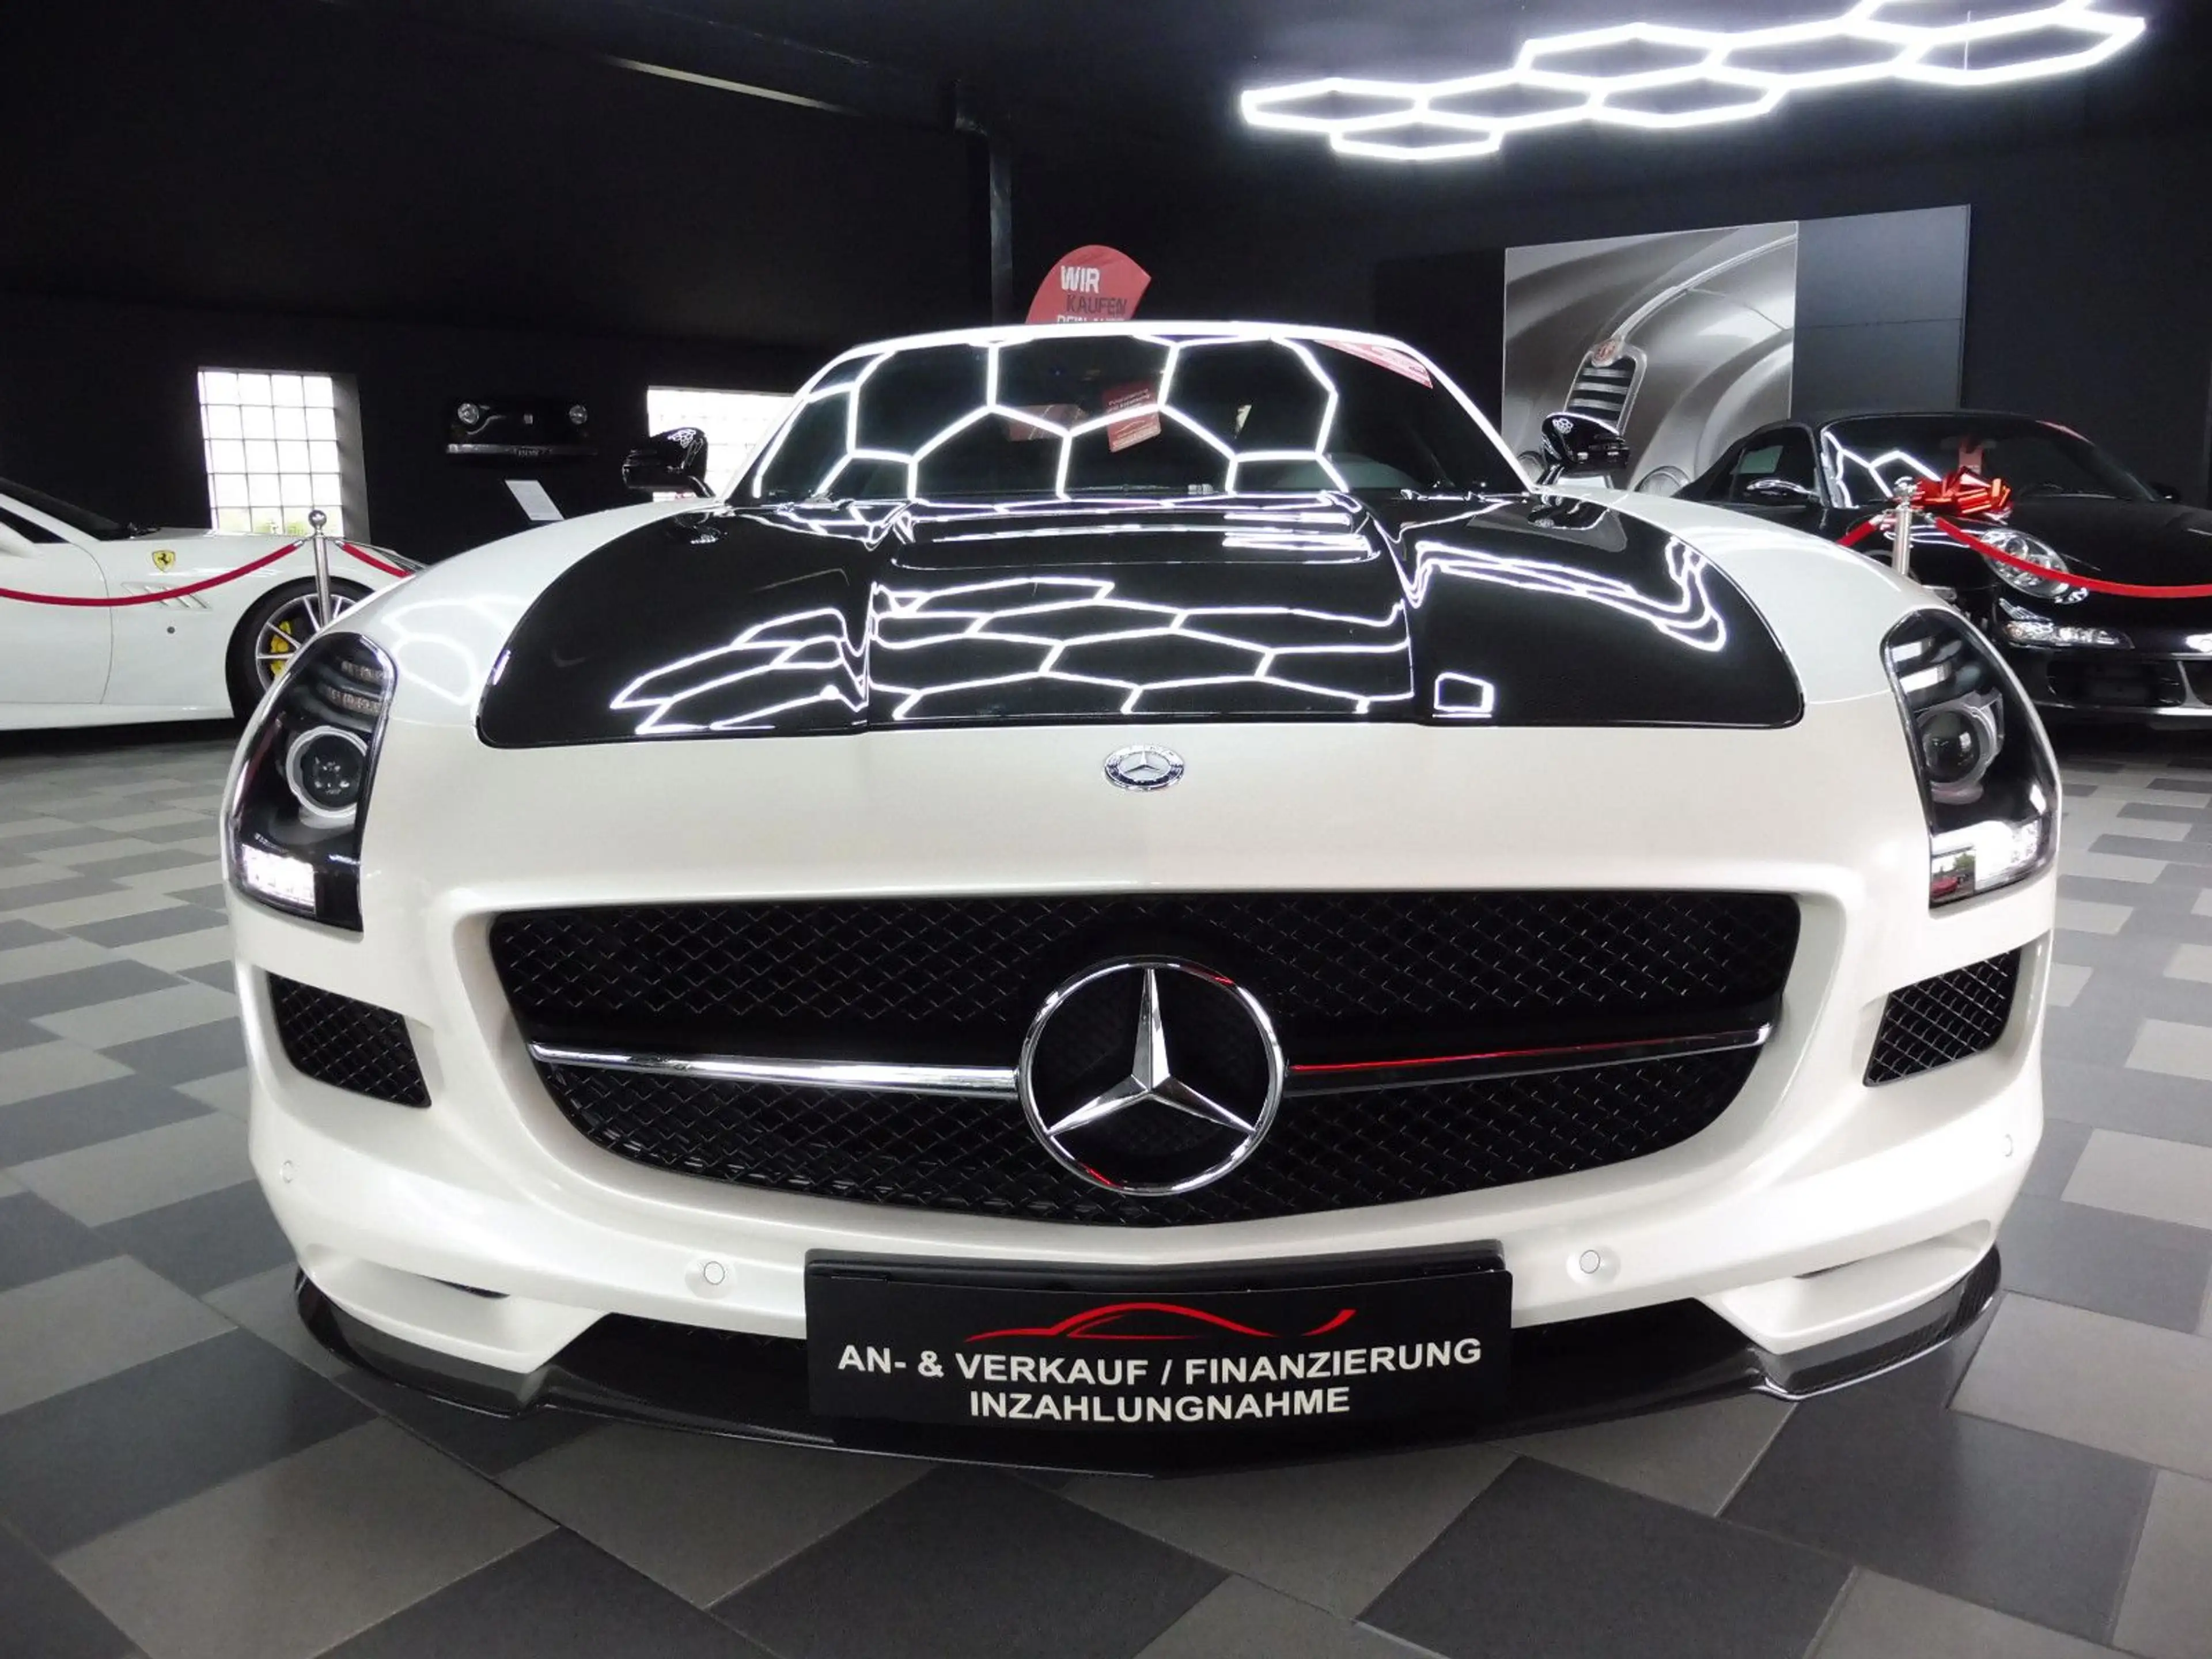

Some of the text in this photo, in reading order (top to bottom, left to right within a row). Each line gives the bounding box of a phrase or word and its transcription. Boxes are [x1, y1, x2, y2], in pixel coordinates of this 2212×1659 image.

[1060, 266, 1100, 294] WIR
[1066, 294, 1127, 316] KAUFEN
[838, 1338, 1481, 1385] AN- & VERKAUF / FINANZIERUNG
[971, 1387, 1350, 1422] INZAHLUNGNAHME
